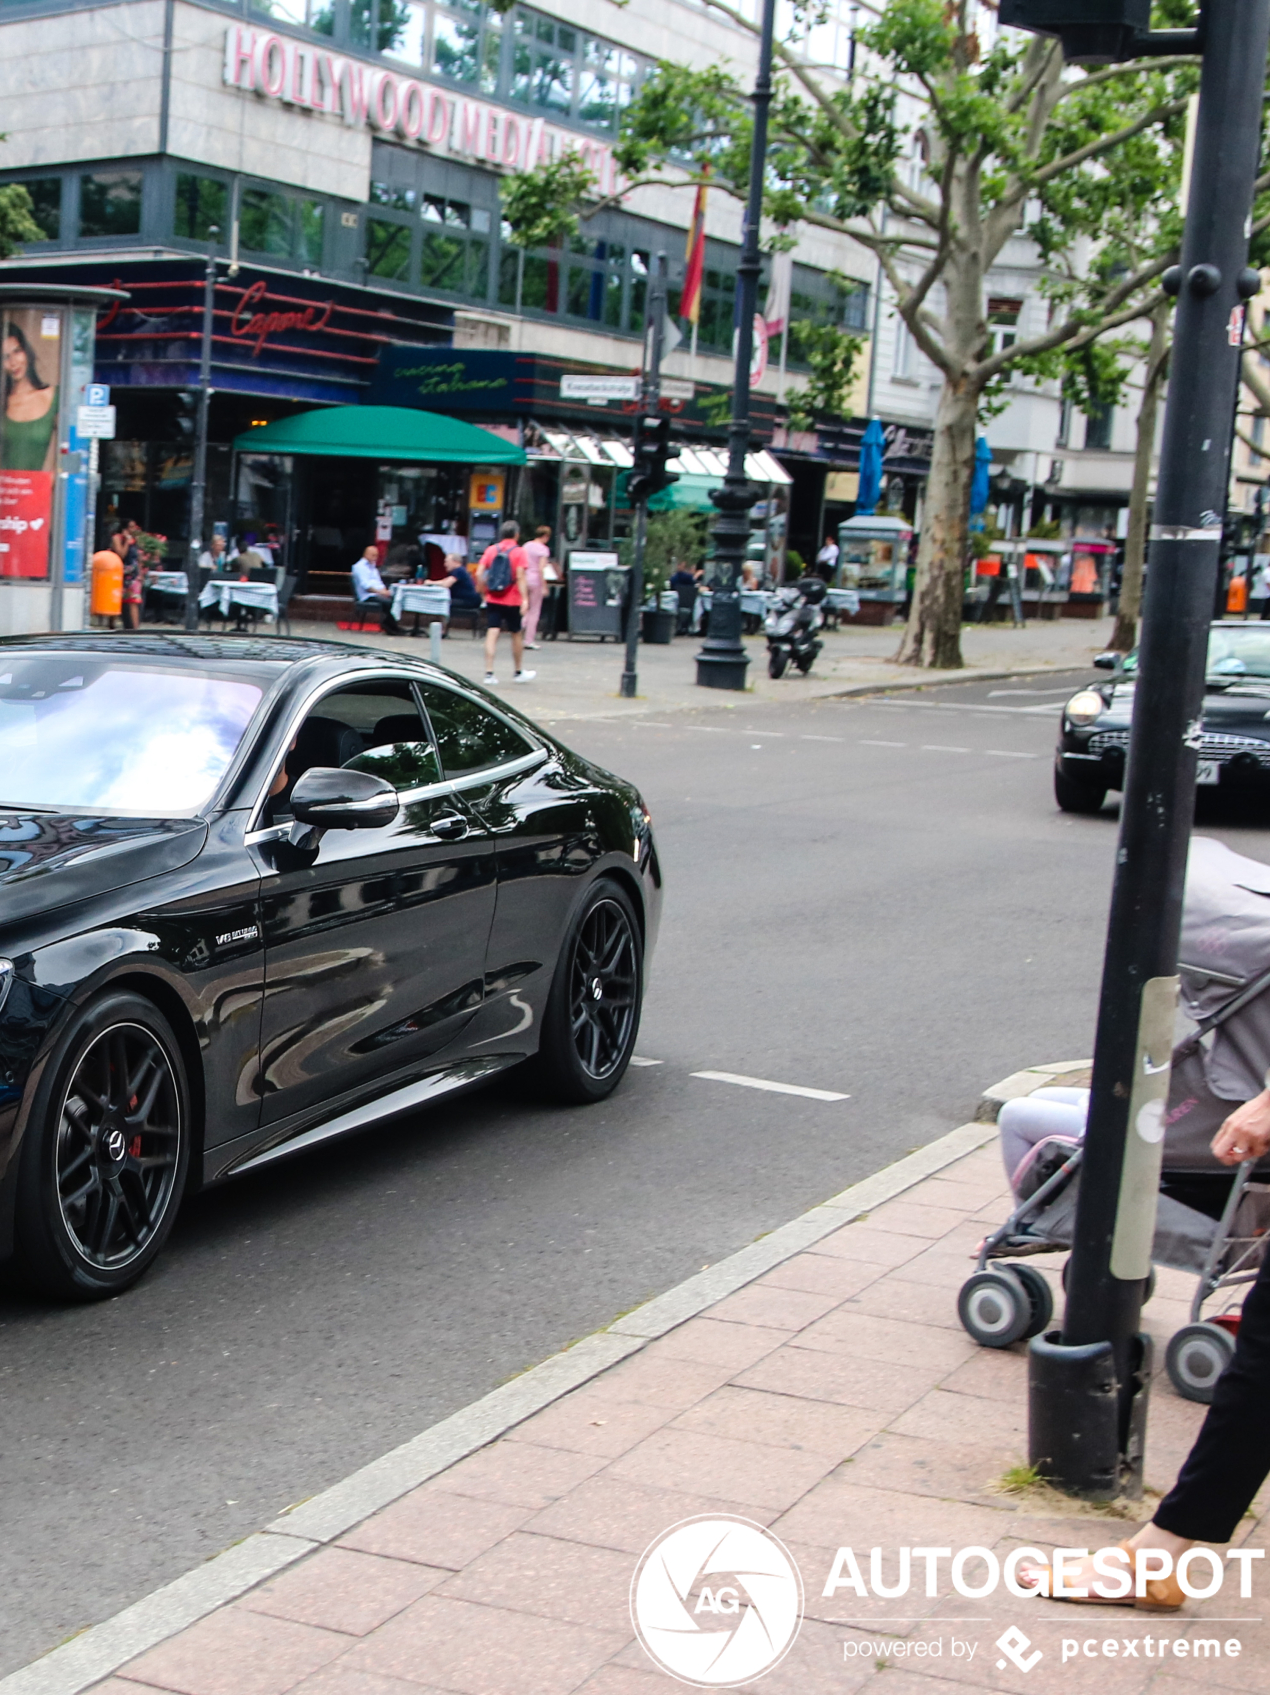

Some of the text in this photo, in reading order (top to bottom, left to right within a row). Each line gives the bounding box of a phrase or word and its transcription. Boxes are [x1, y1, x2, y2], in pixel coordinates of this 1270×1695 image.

[224, 26, 447, 143] HOLLYWOOD
[454, 101, 547, 171] MEDIA
[232, 281, 333, 357] Capone
[477, 485, 497, 503] EC
